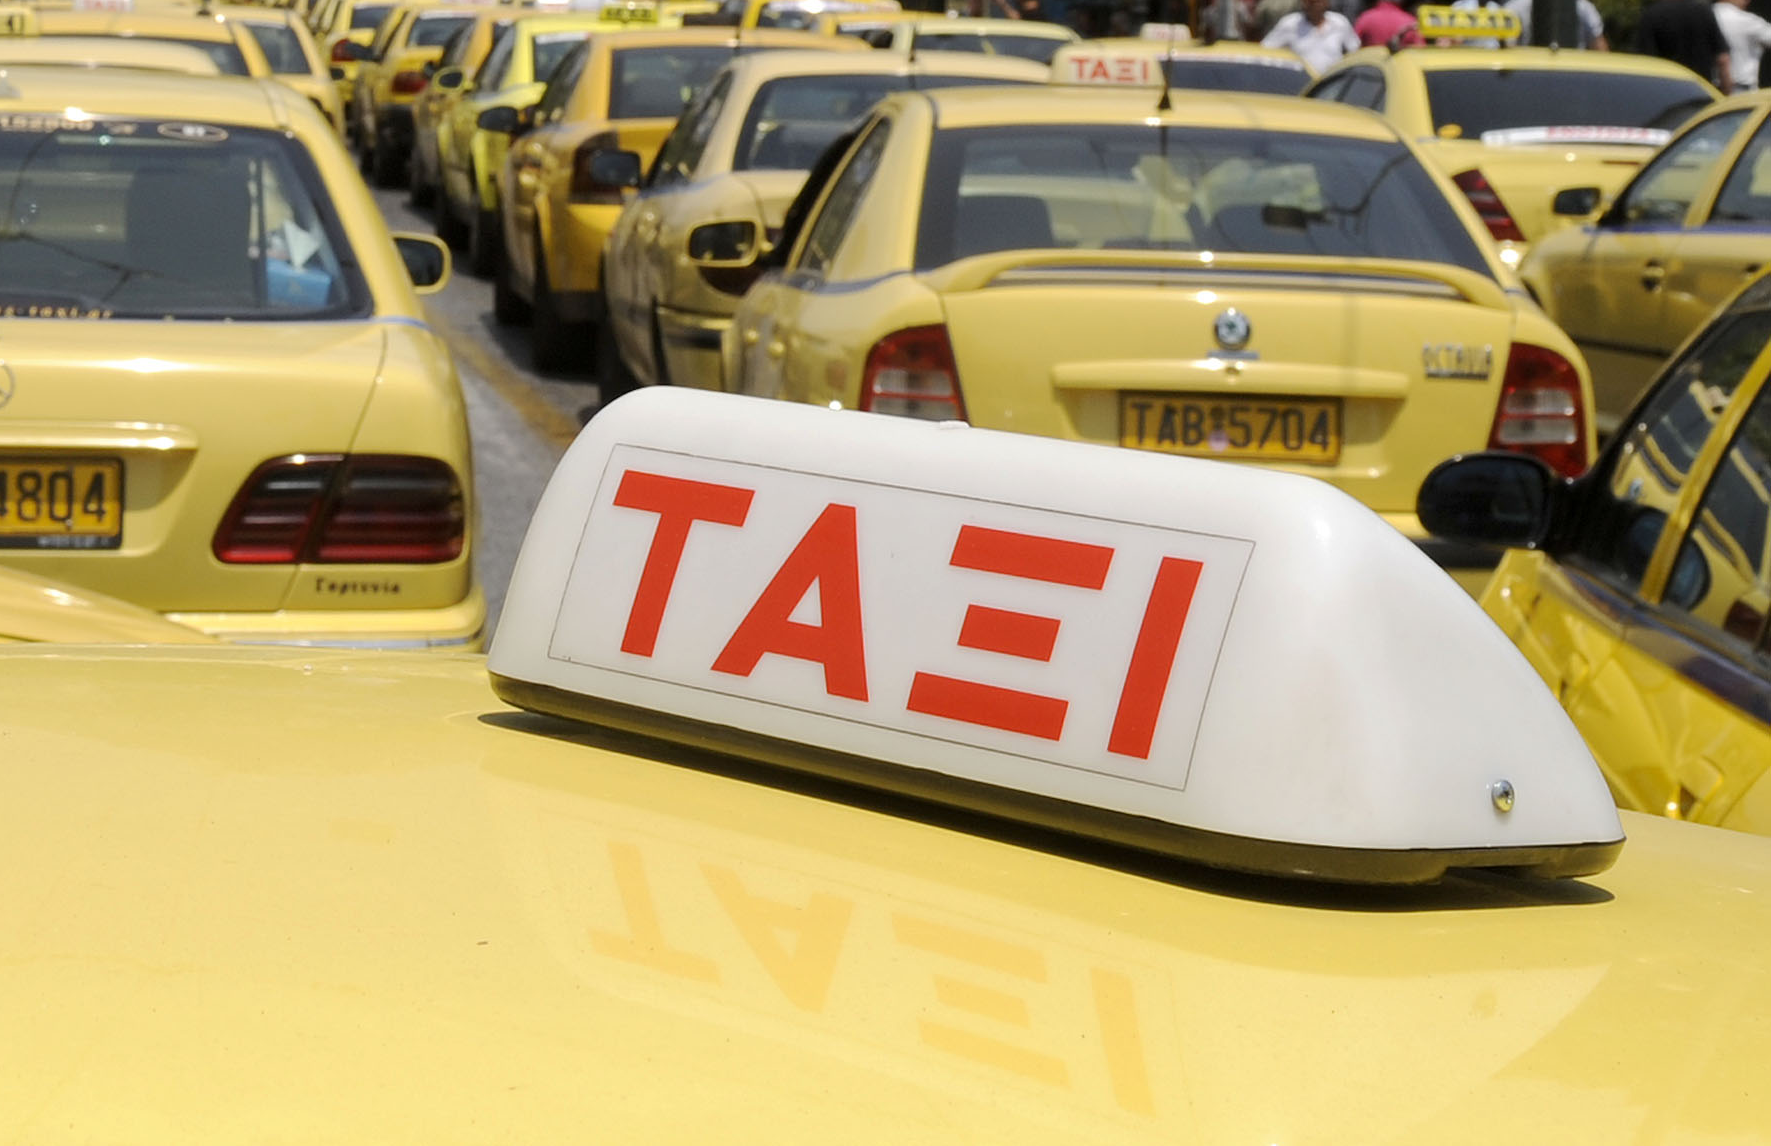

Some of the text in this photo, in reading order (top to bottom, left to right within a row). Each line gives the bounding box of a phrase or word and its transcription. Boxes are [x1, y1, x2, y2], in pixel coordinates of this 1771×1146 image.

[1069, 57, 1150, 82] ΤΑΞΙ
[1229, 406, 1331, 452] 5704
[613, 469, 1203, 760] ΤΑΞΙ
